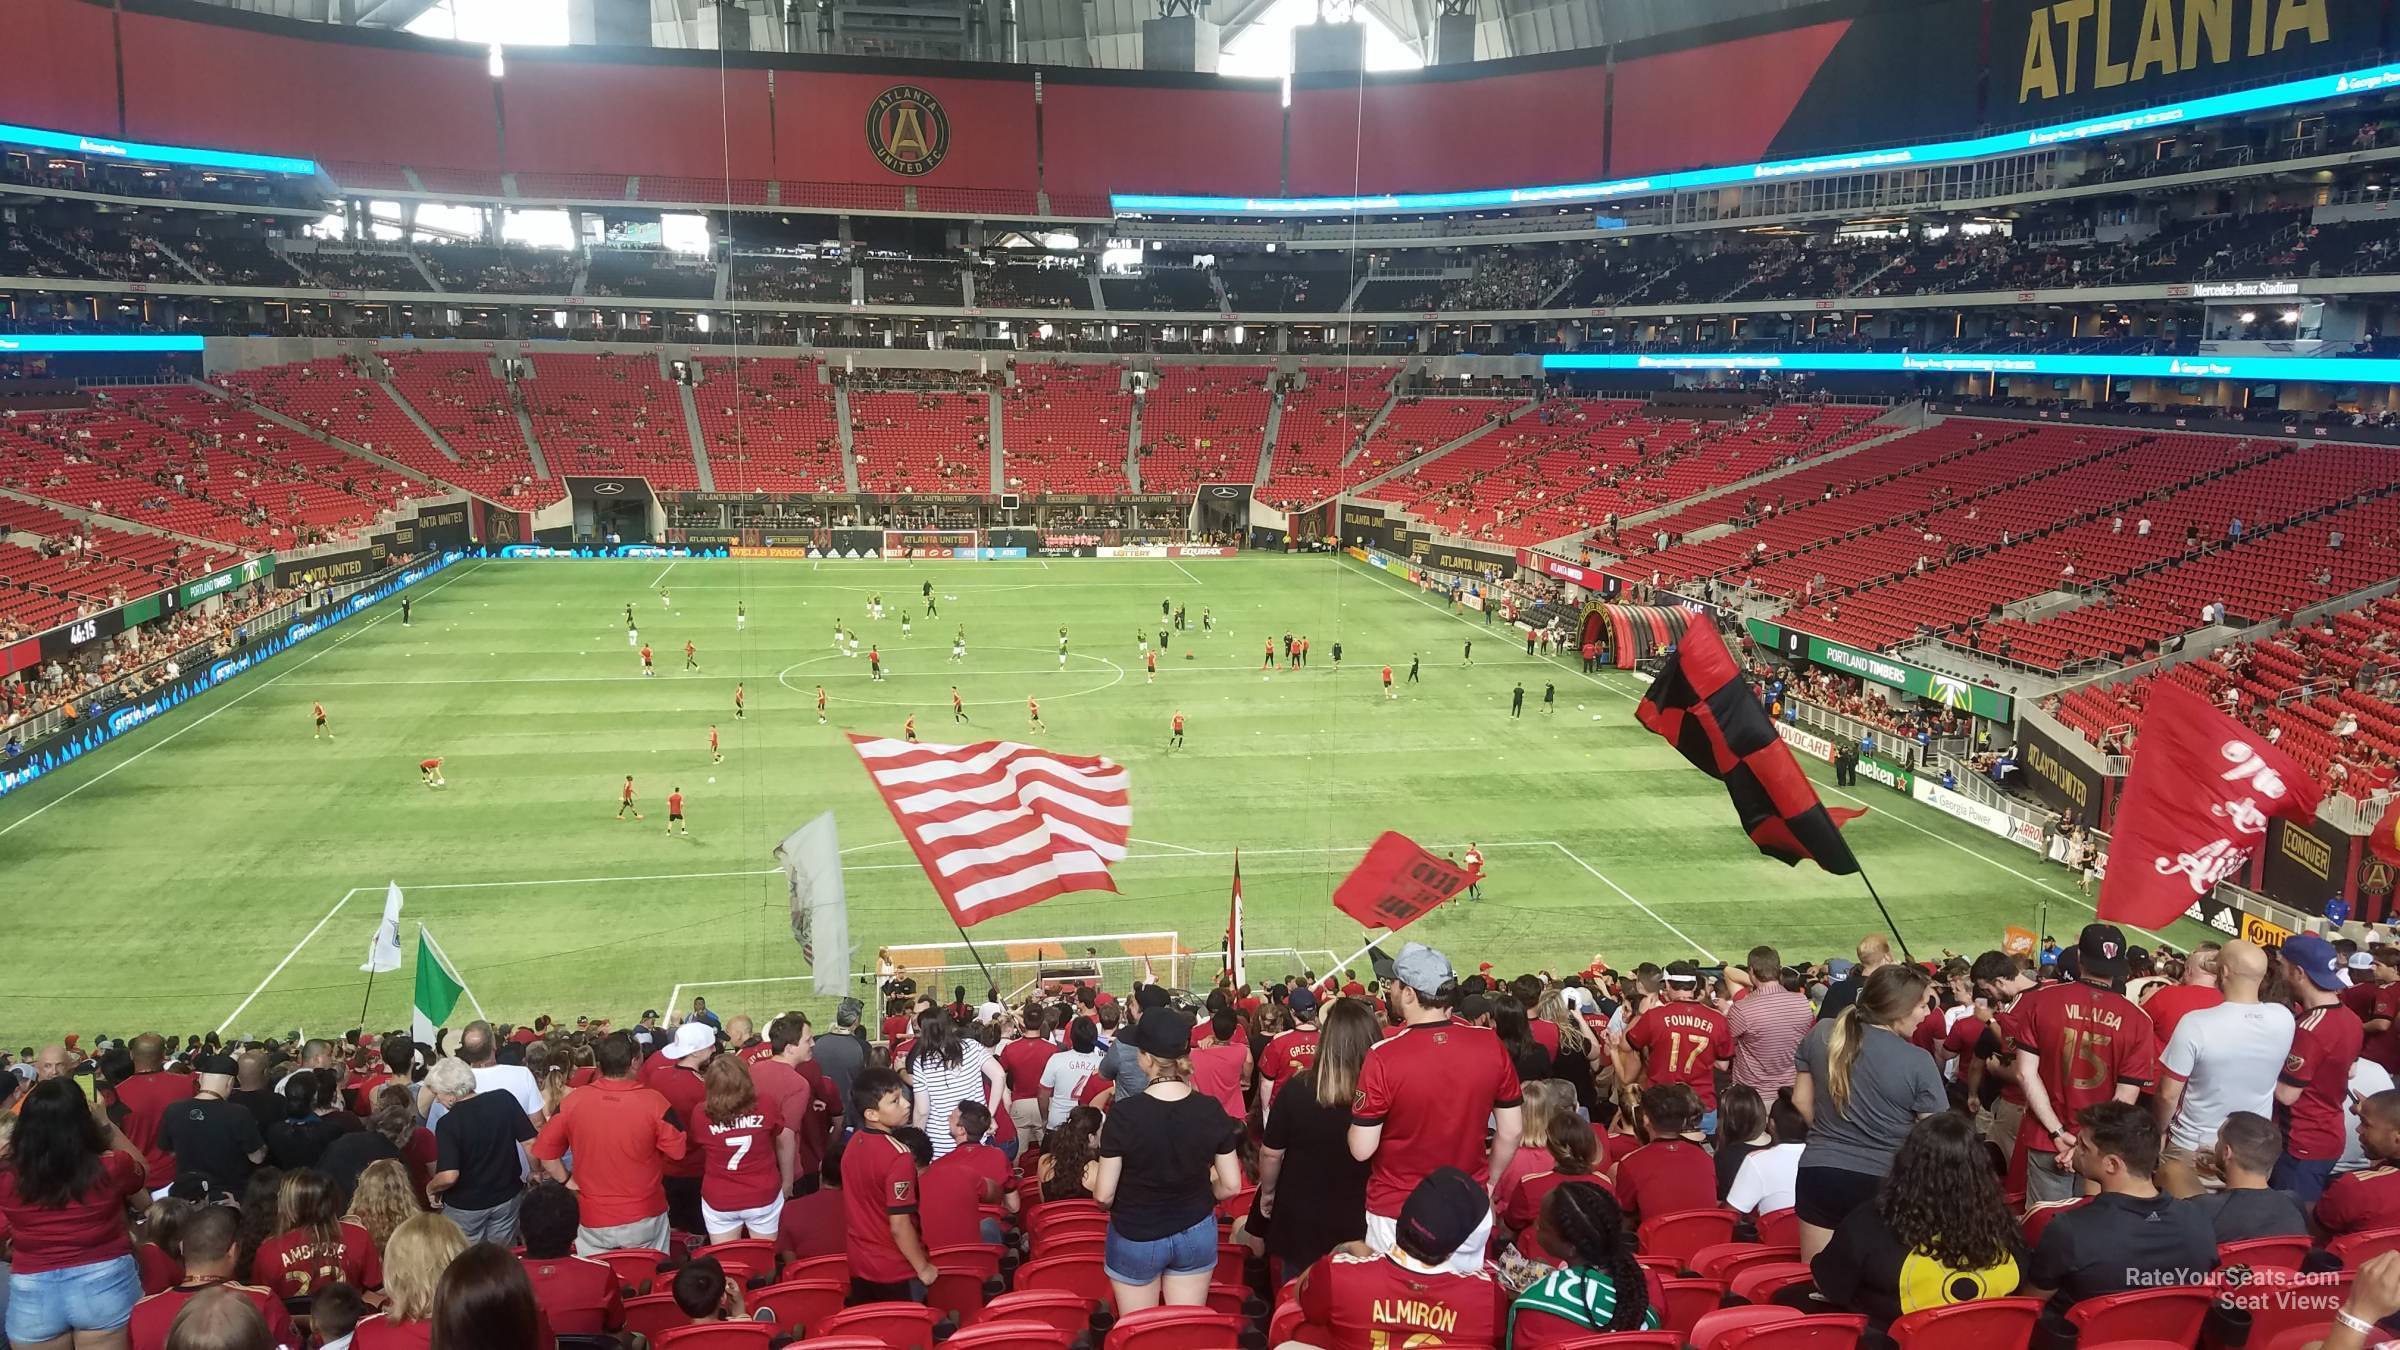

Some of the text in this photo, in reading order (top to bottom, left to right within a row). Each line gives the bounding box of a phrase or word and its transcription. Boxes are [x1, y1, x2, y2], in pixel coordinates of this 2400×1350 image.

[879, 89, 936, 112] ATLANTA
[877, 148, 941, 173] UNITED FC
[2193, 283, 2257, 297] Mercedes-Benz
[2259, 281, 2298, 294] Stadium
[696, 493, 754, 501] ATLANTA UNITED
[1120, 495, 1171, 503] ATLANTA UNITED
[439, 512, 463, 526] UNITED
[1344, 512, 1370, 526] ATLANTA
[903, 535, 969, 544] ATLANTA UNITED
[731, 548, 805, 557] WELLS FARGO
[1180, 547, 1224, 556] EQUIFAX
[329, 560, 362, 579] UNITED
[1440, 555, 1473, 570] ATLANTA
[189, 580, 214, 598] PORTLAND
[70, 619, 96, 645] 46:15
[1790, 634, 1797, 650] 0
[1826, 646, 1906, 684] PORTLAND TIMBERS
[2028, 742, 2088, 808] ATLANTA UNITED
[1939, 794, 1992, 826] Georgia Power
[2285, 828, 2329, 872] CONQUER
[2211, 919, 2238, 936] adidas
[1664, 1015, 1714, 1034] FOUNDER
[1668, 1031, 1710, 1074] 17
[2062, 1027, 2112, 1090] 15
[1069, 1060, 1096, 1071] GARZA
[725, 1135, 753, 1171] 7
[1372, 1300, 1458, 1334] ALMIRÓN
